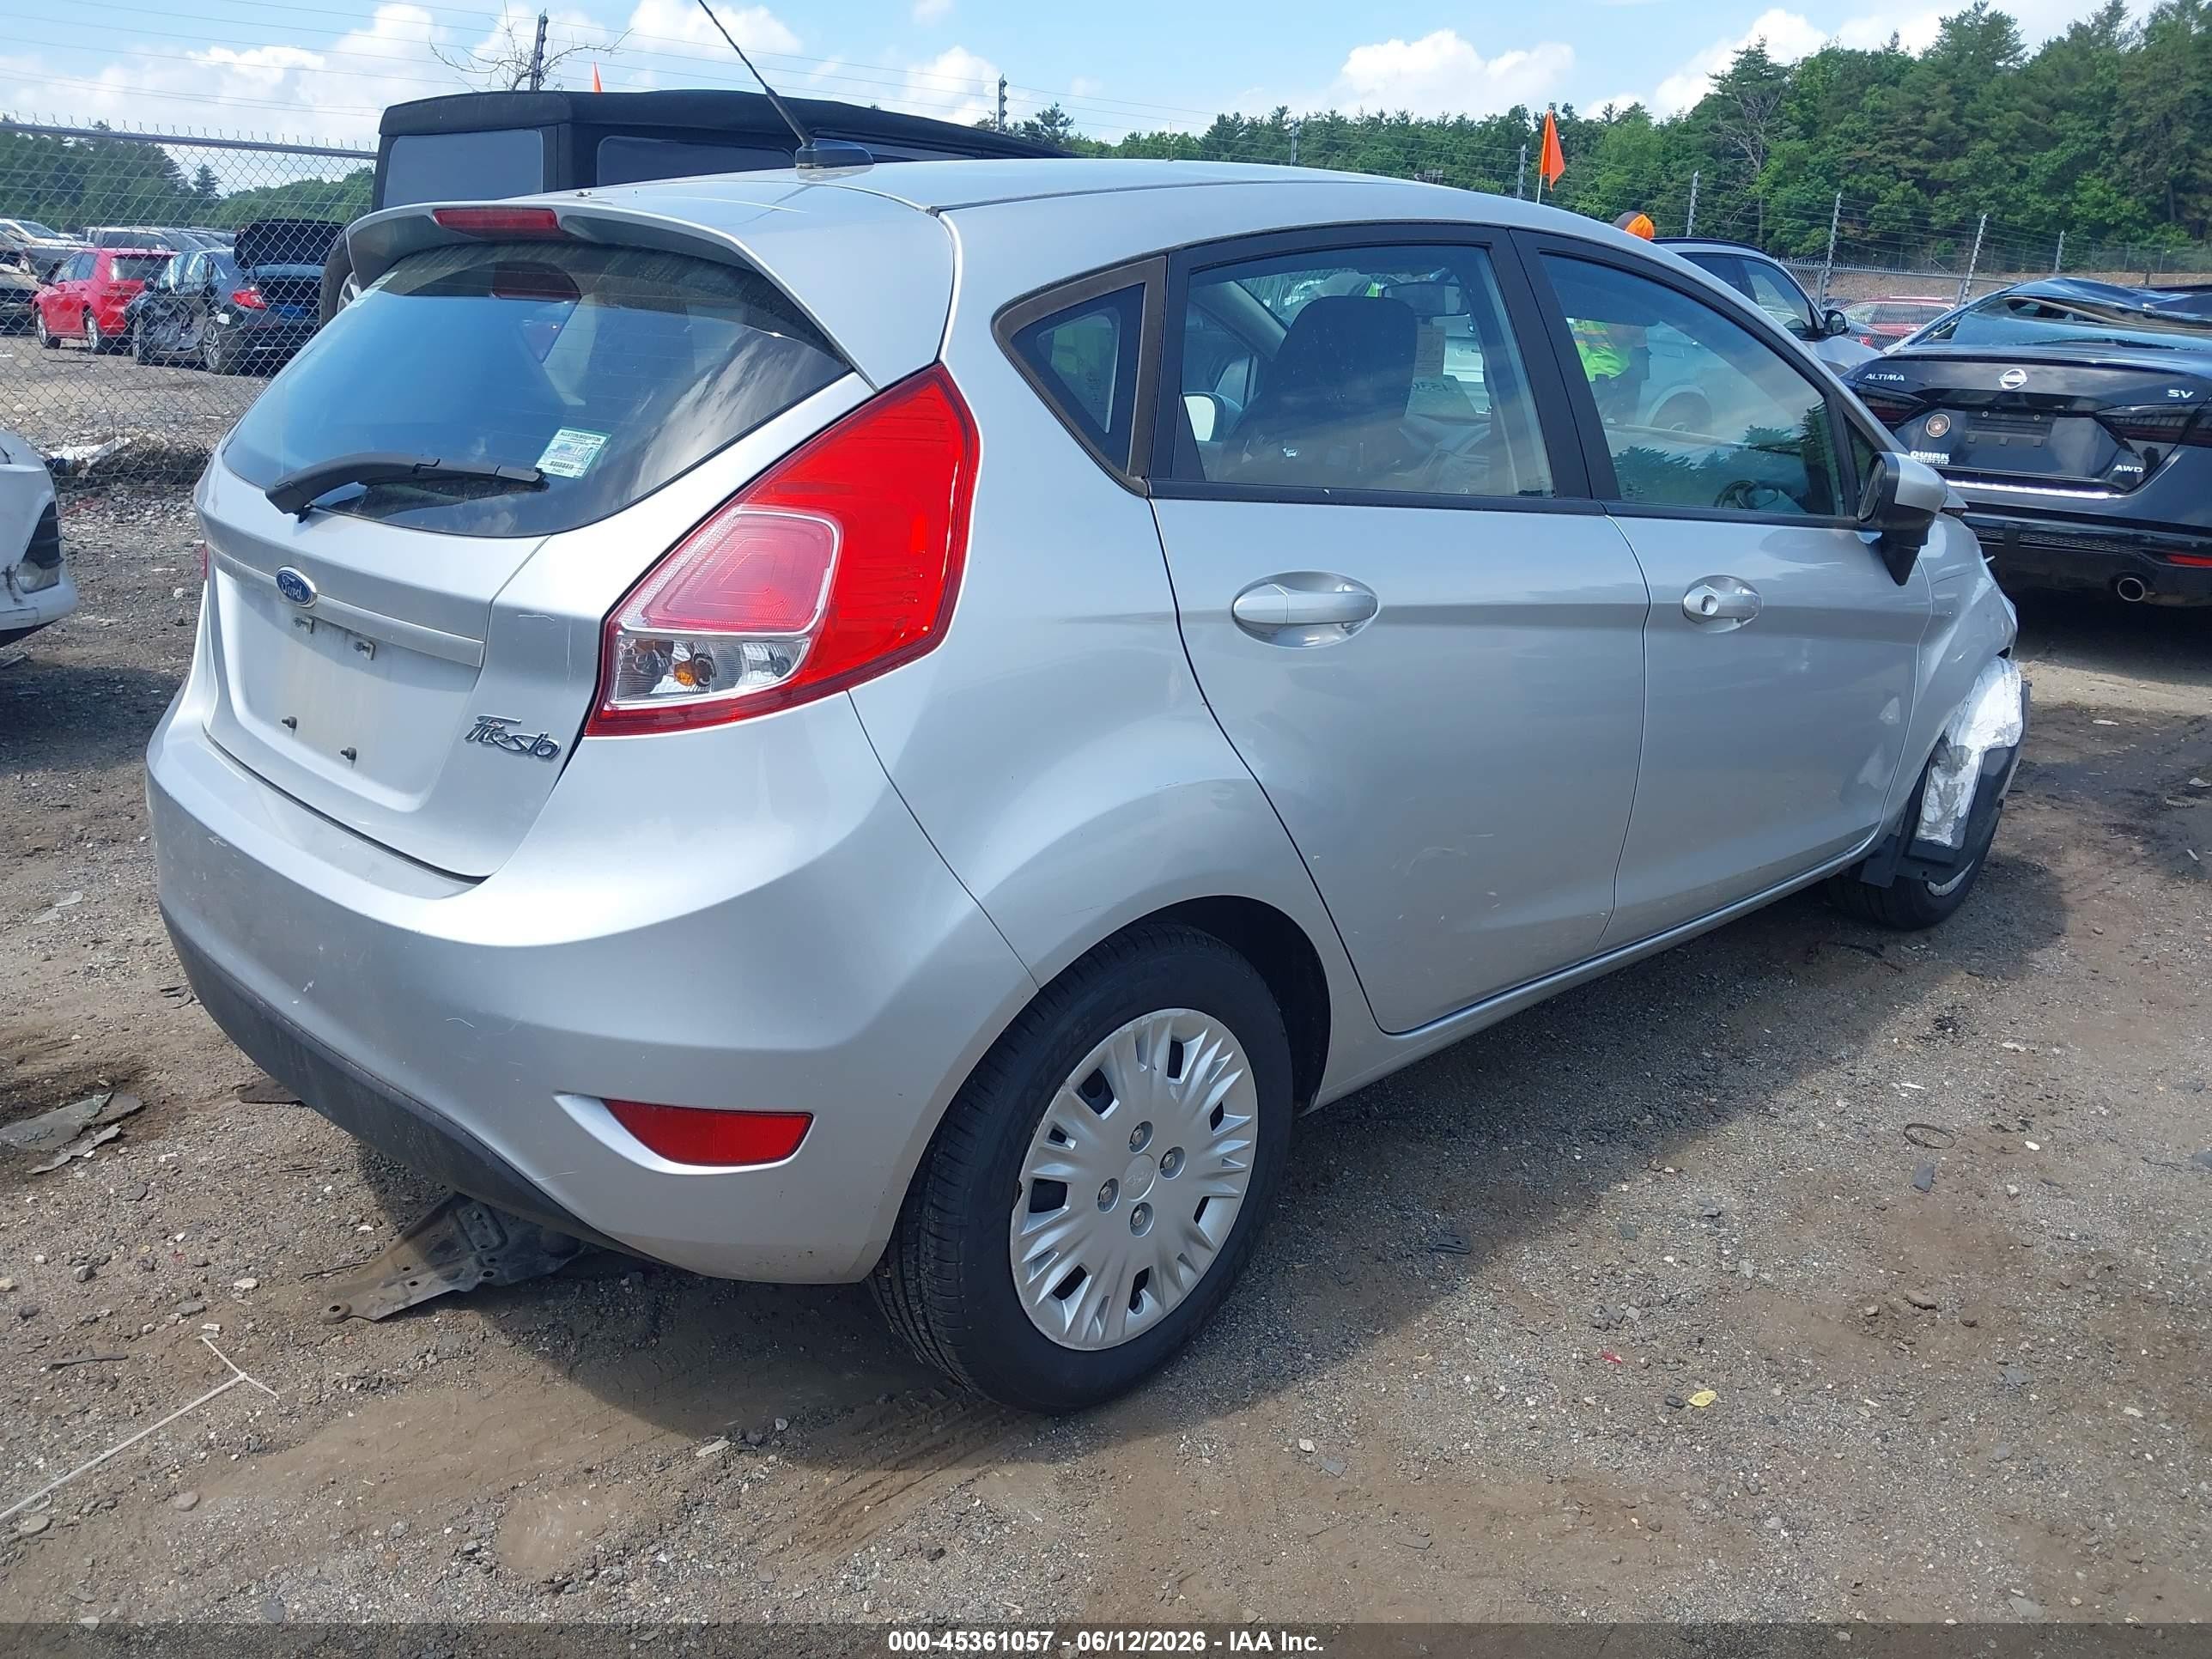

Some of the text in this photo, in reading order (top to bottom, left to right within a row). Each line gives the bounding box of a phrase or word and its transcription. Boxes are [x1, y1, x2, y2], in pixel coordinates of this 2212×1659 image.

[1864, 373, 1905, 381] ALTIMA
[2167, 389, 2194, 398] SV
[2113, 465, 2143, 473] AWD
[281, 574, 303, 600] Ford
[465, 714, 562, 760] Fiesta
